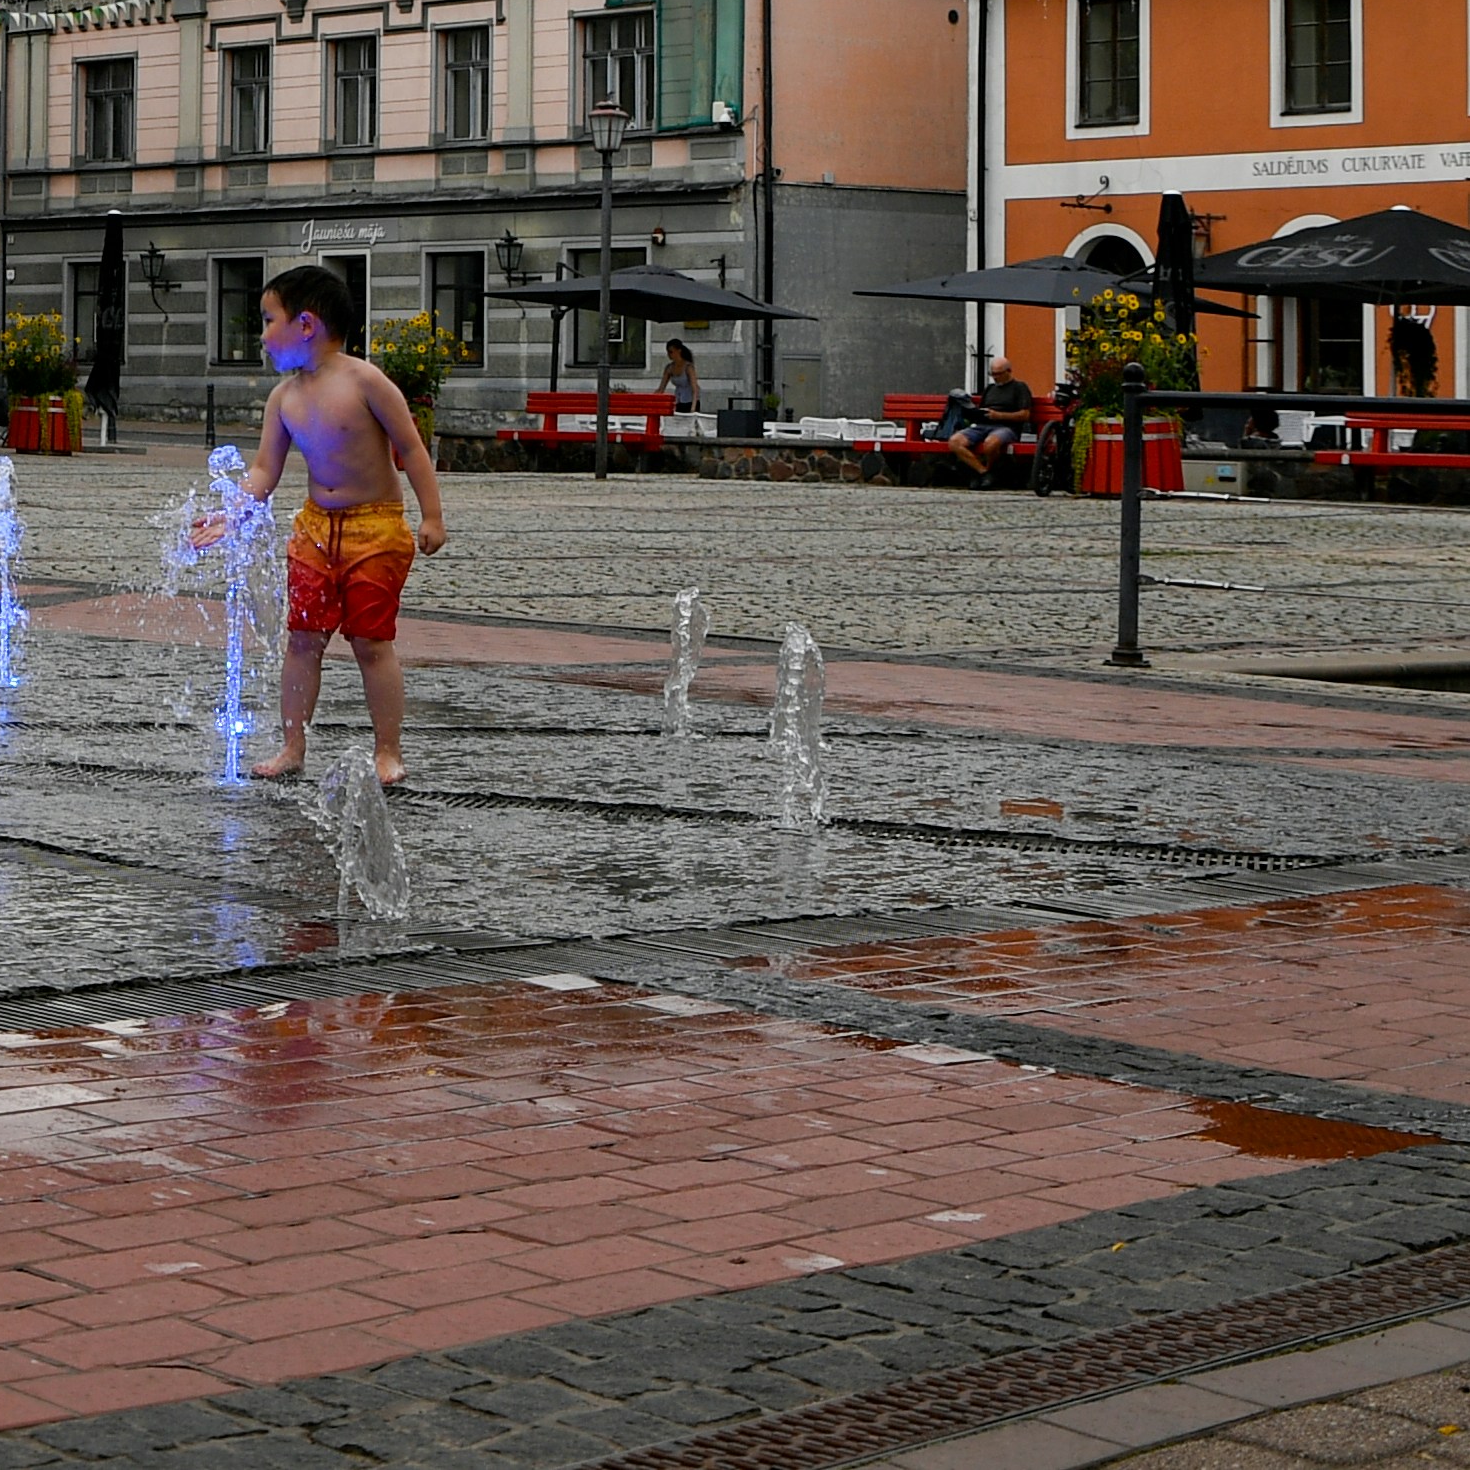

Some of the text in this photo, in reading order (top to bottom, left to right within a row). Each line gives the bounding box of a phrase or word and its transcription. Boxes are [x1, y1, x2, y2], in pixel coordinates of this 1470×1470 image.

[1252, 157, 1329, 177] SALDĒJUMS
[1342, 154, 1426, 173] CUKURVATE
[300, 218, 387, 253] Jauniešu māja
